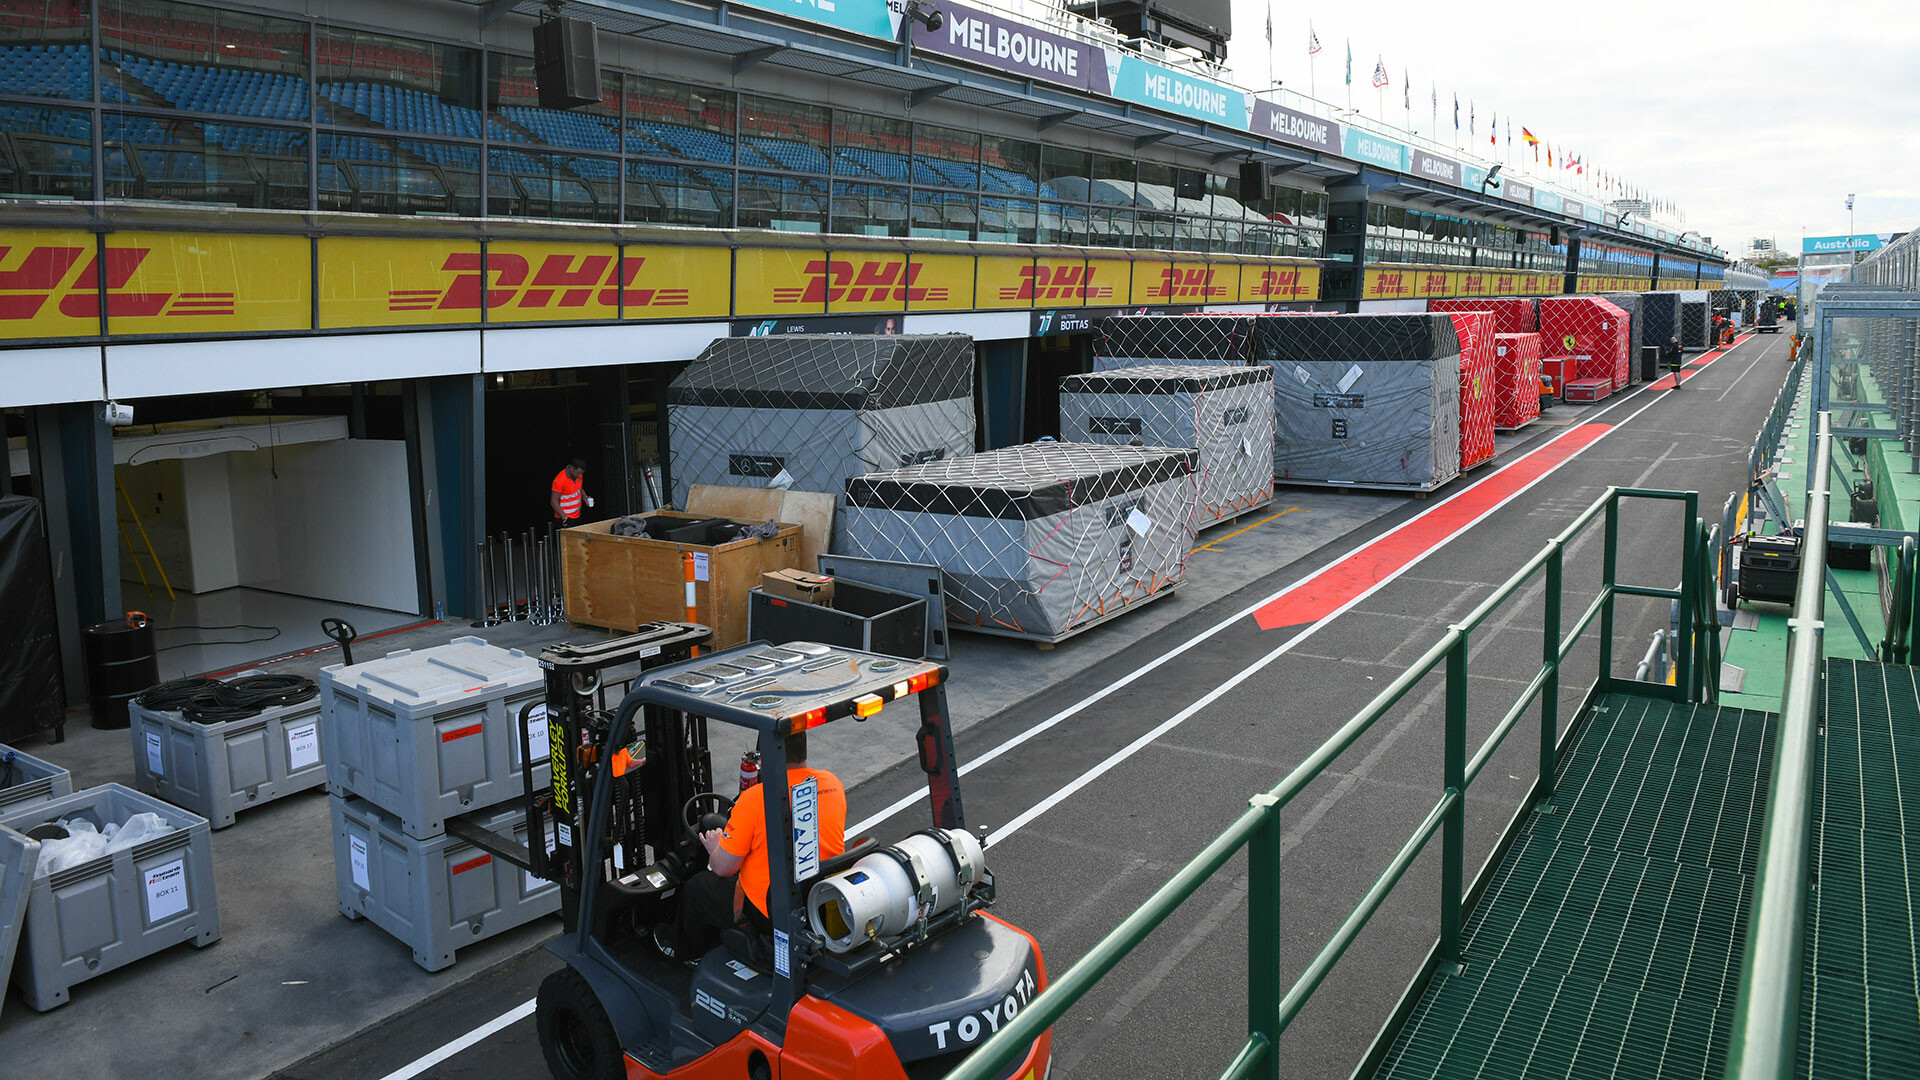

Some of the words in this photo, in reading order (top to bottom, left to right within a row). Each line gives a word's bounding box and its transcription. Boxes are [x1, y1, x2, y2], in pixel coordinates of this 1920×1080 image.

[949, 11, 1079, 77] MELBOURNE
[1144, 71, 1227, 117] MELBOURNE
[1270, 109, 1328, 145] MELBOURNE
[1357, 138, 1400, 165] MELBOURNE
[1421, 157, 1454, 180] MELBOURNE
[1814, 237, 1870, 250] Australia
[437, 252, 656, 310] DHL
[800, 260, 929, 303] DHL
[1016, 265, 1099, 300] DHL
[1158, 268, 1217, 297] DHL
[1259, 271, 1302, 296] DHL
[1375, 274, 1404, 293] DHL
[1425, 275, 1448, 293] DHL
[786, 325, 805, 333] LEWIS
[1039, 315, 1053, 332] 77
[1060, 319, 1088, 331] BOTTAS
[537, 730, 545, 738] 10
[549, 718, 563, 809] WAVERLEY
[556, 722, 571, 814] FORKLIFTS
[796, 786, 813, 823] 6UB
[799, 840, 815, 876] 1KY
[156, 888, 170, 899] BOX
[170, 885, 178, 894] 11
[695, 988, 726, 1020] 25
[929, 968, 1035, 1050] TOYOTA
